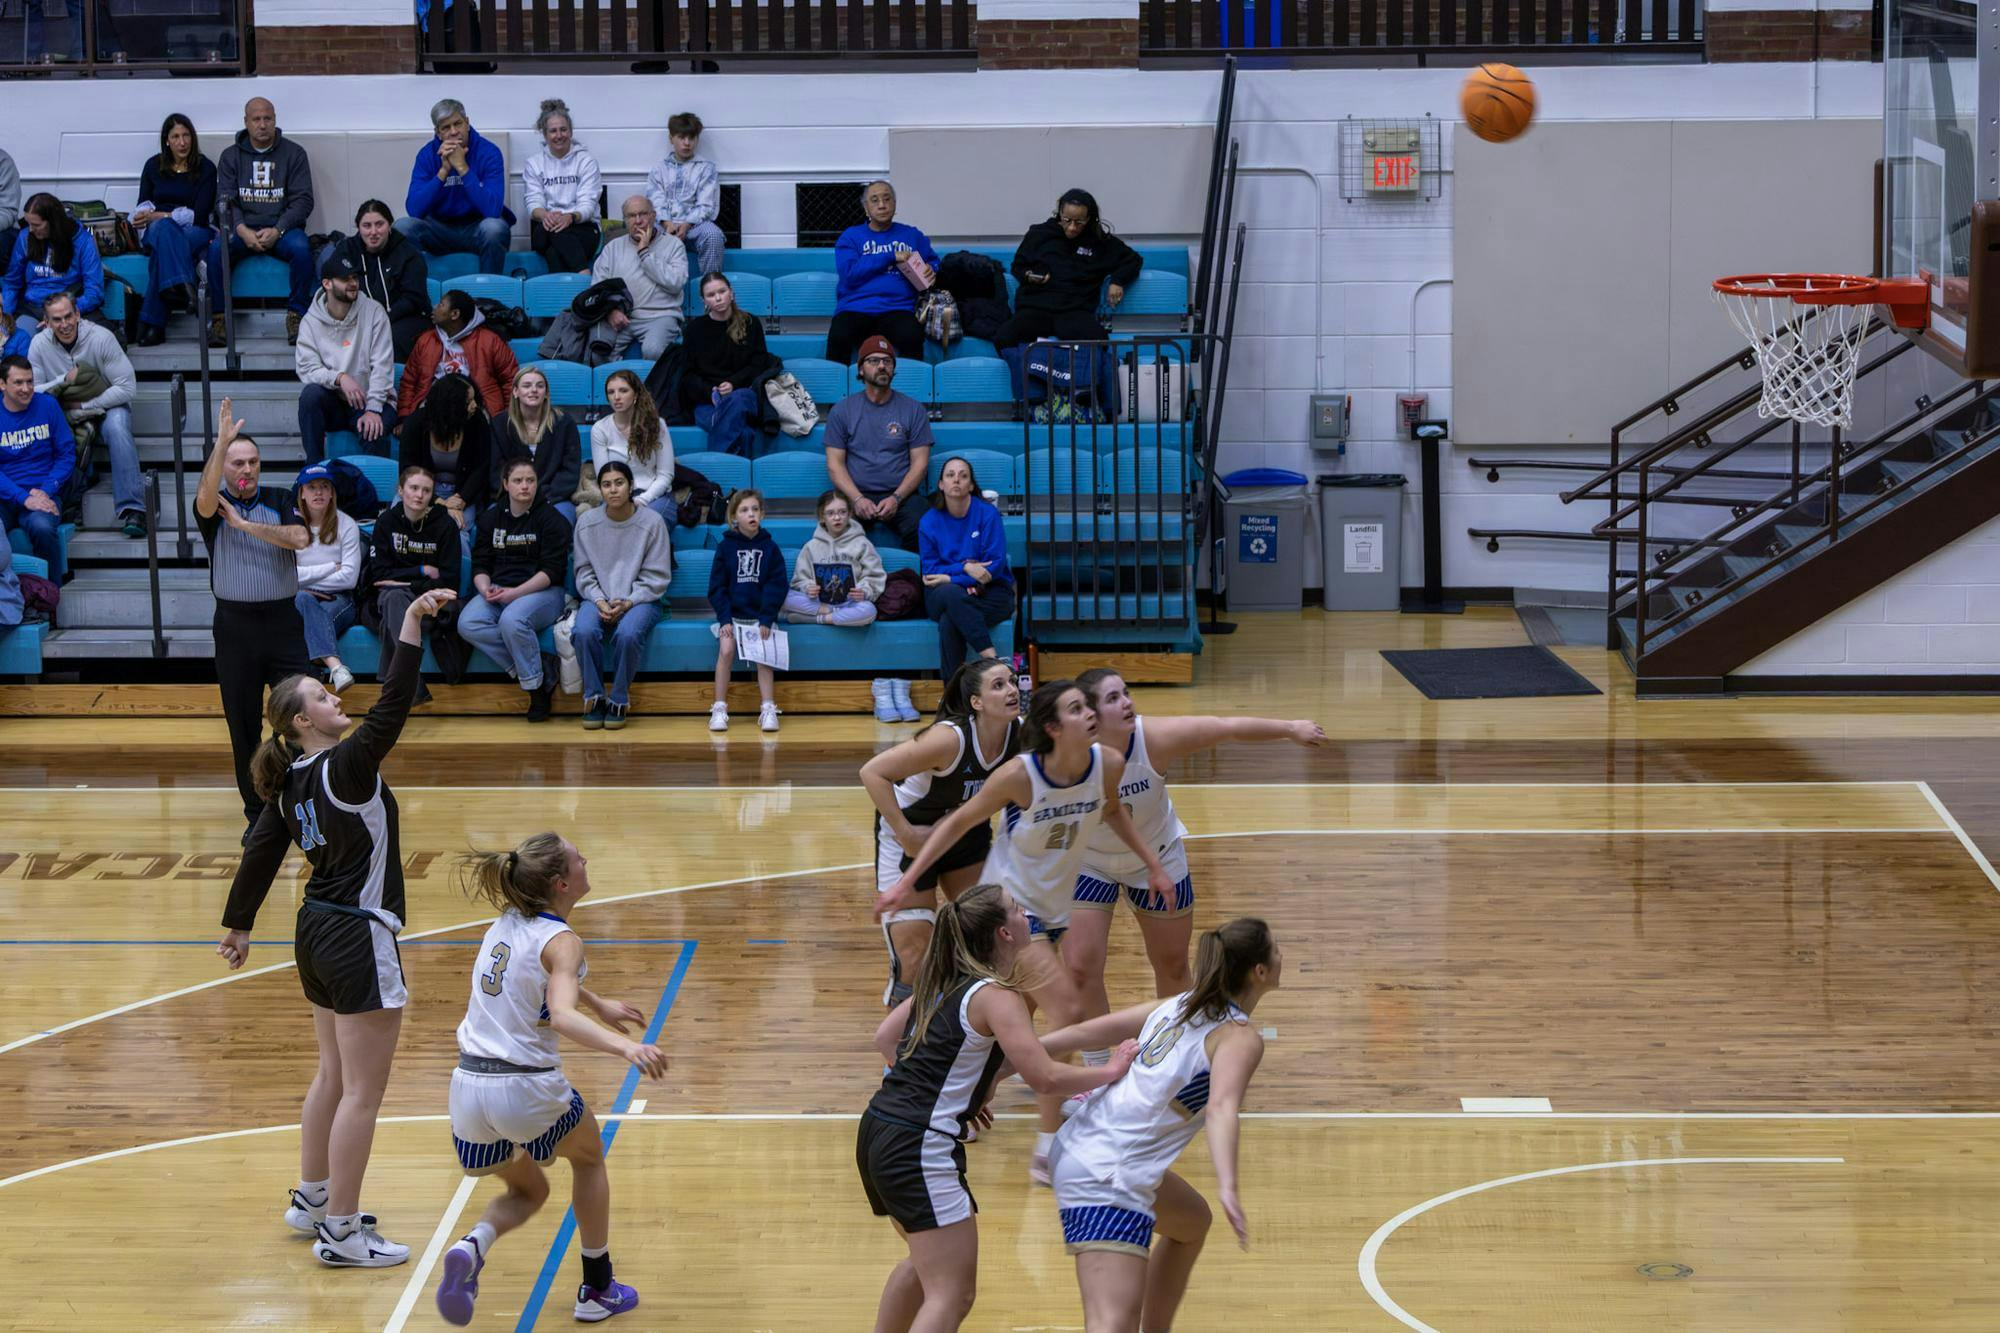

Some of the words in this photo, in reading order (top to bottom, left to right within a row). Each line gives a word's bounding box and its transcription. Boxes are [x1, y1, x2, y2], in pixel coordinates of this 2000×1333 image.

[1374, 157, 1411, 187] EXIT
[1241, 523, 1276, 533] Recycling
[1248, 516, 1270, 525] Mixed
[1350, 525, 1377, 533] Landfill
[1033, 798, 1100, 823] HAMILTON
[1044, 820, 1079, 850] 21
[481, 941, 511, 997] 3
